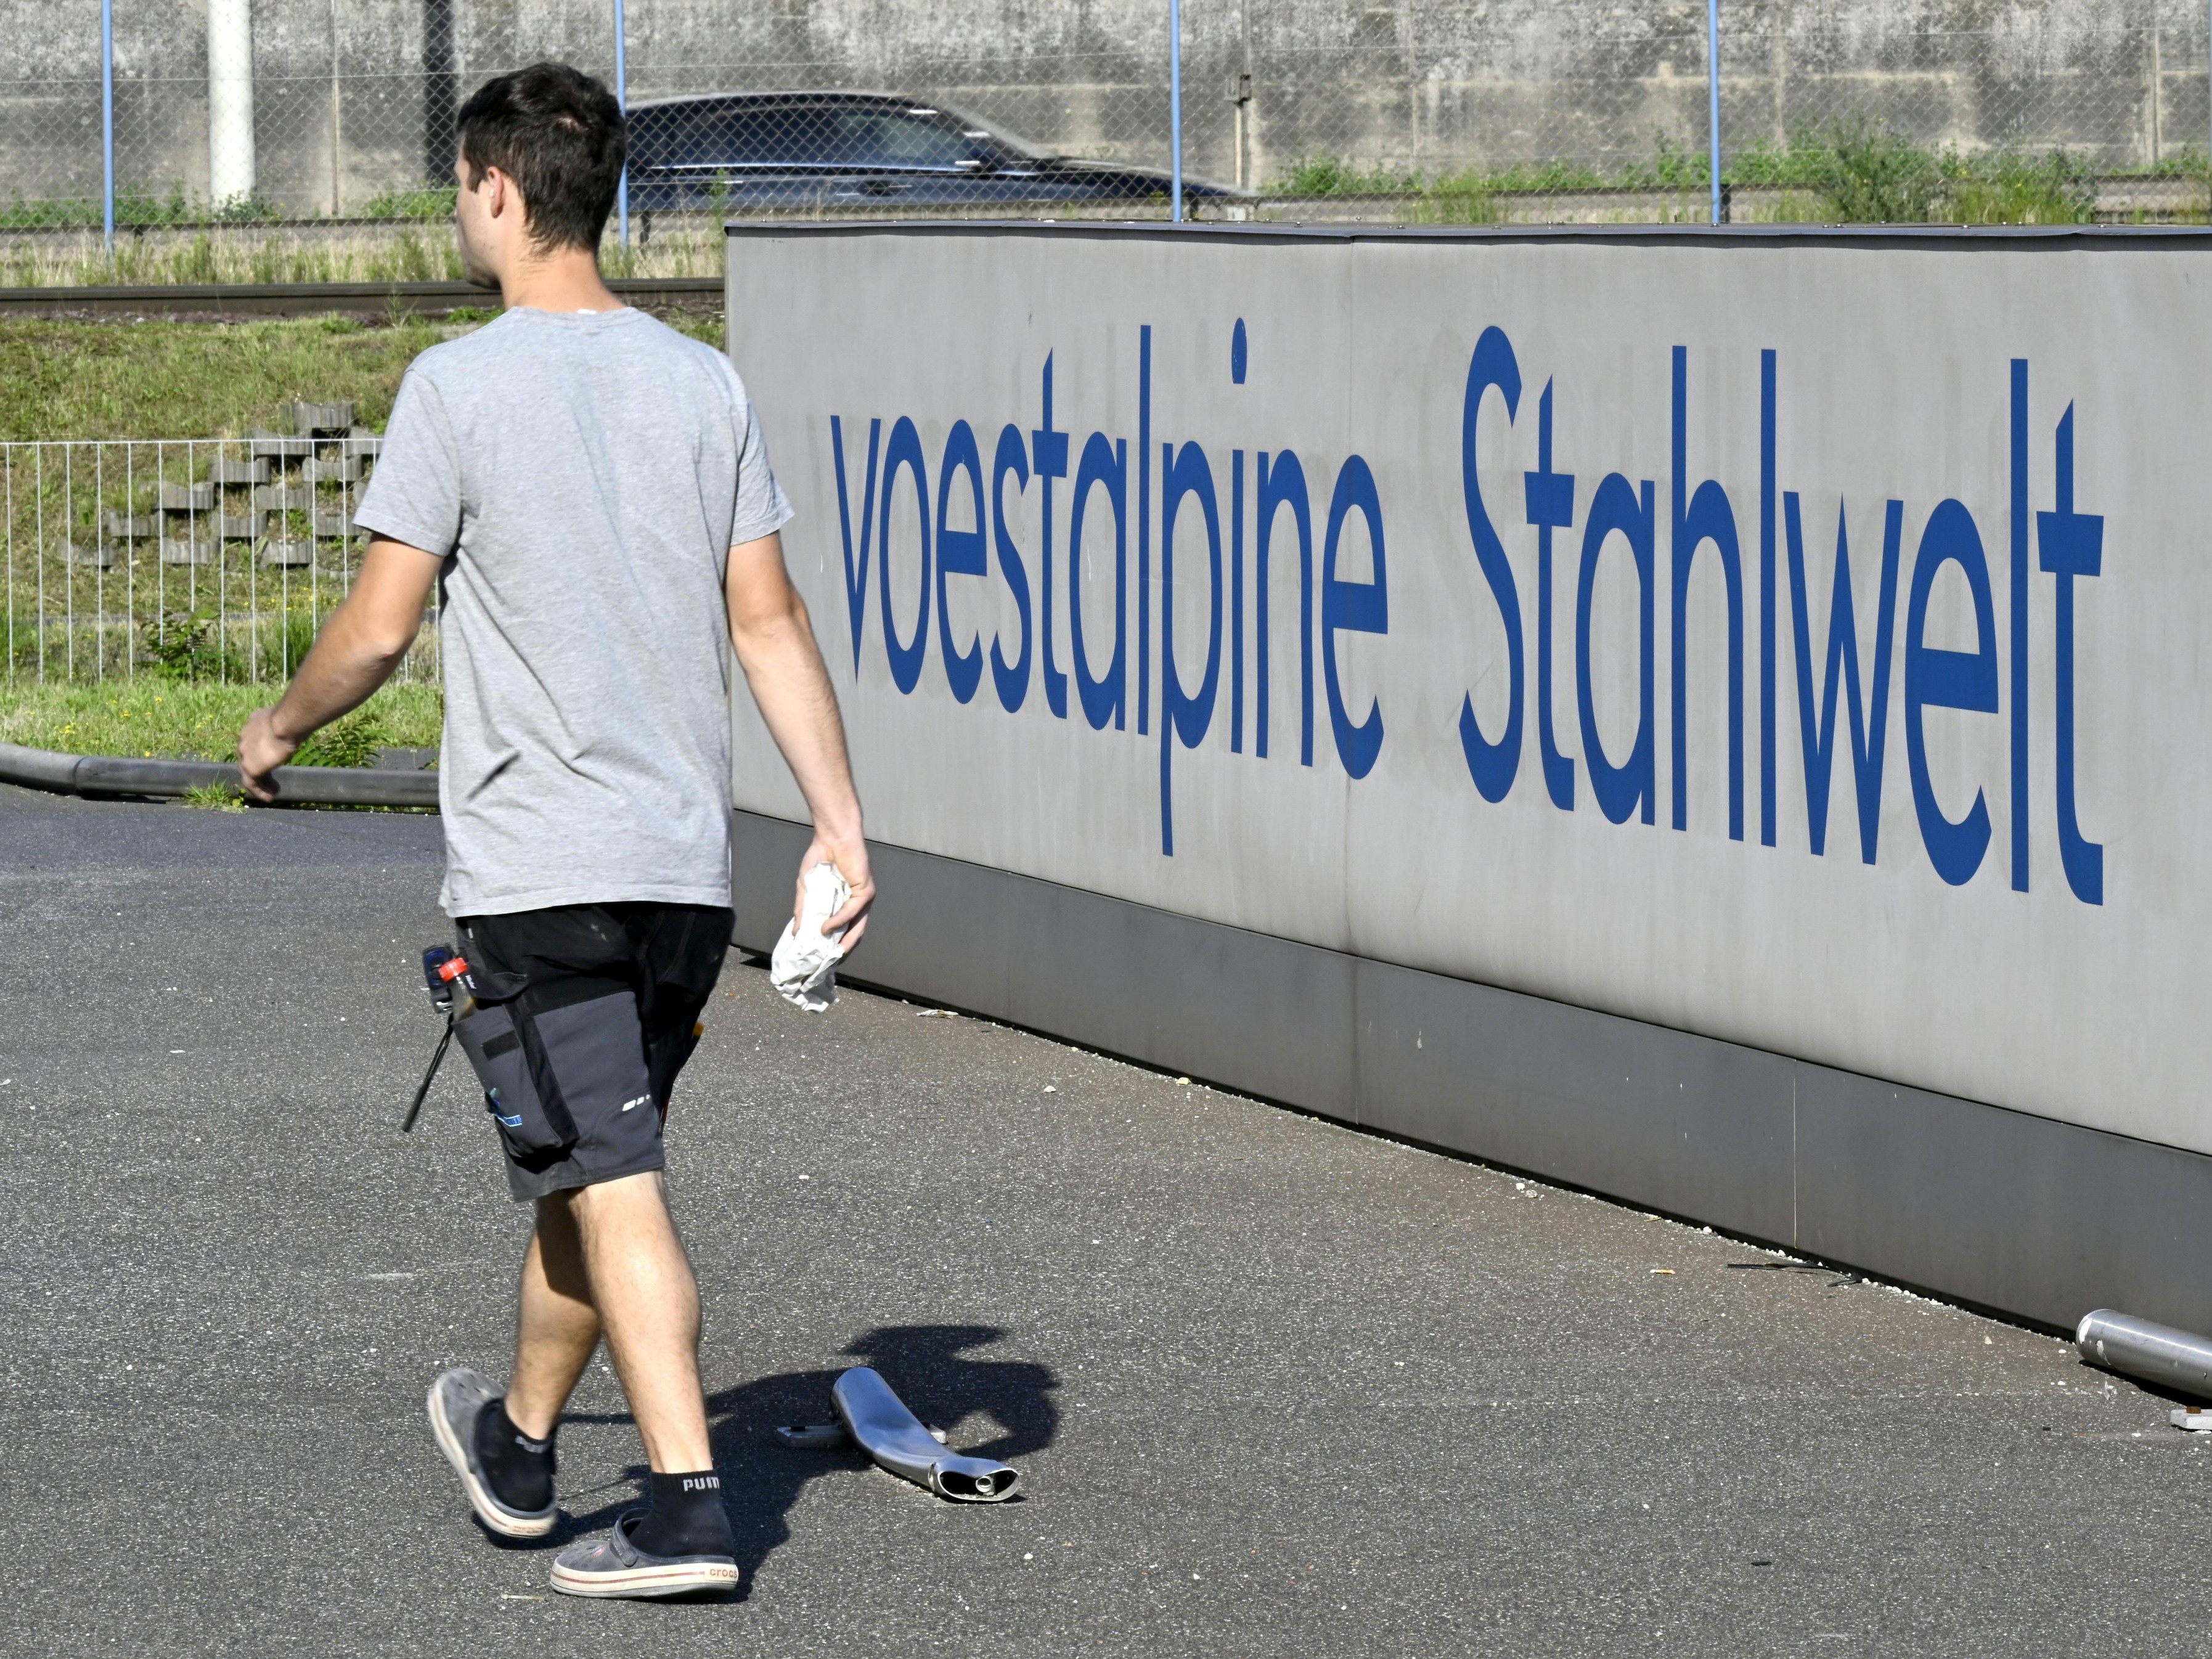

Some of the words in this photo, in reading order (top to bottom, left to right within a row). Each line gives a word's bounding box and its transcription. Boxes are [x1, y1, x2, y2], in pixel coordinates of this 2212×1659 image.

[831, 318, 1389, 856] voestalpine
[1458, 325, 2105, 905] Stahlwelt
[710, 1568, 738, 1578] crocs
